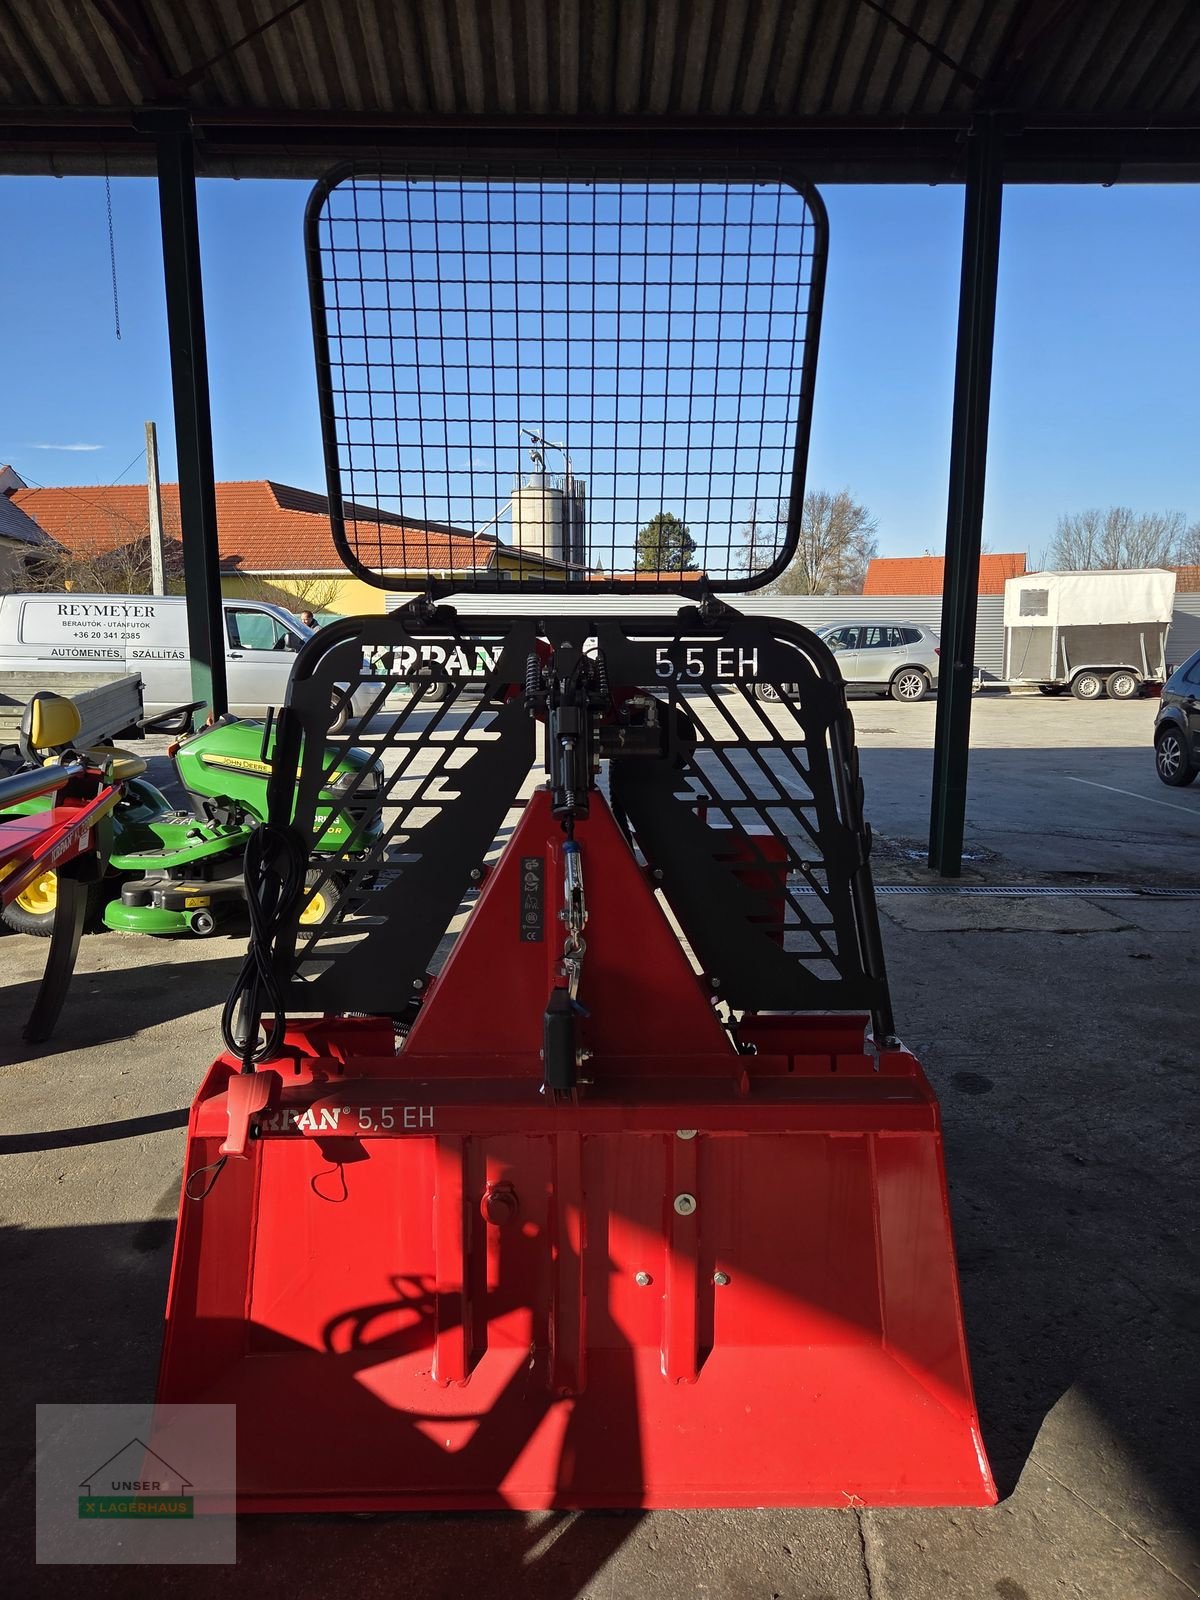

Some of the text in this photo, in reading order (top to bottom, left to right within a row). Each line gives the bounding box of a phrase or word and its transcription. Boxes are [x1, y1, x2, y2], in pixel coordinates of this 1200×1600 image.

[57, 604, 155, 618] REYMEYER
[73, 631, 89, 639] +36
[103, 632, 118, 640] 341
[120, 632, 141, 640] 2385
[132, 650, 185, 659] SZÁLLÍTÁS
[359, 645, 505, 676] KRPAN
[655, 647, 758, 681] 5,5 EH
[223, 757, 242, 767] JOHN
[358, 1107, 395, 1131] 5,5
[403, 1106, 434, 1128] EH
